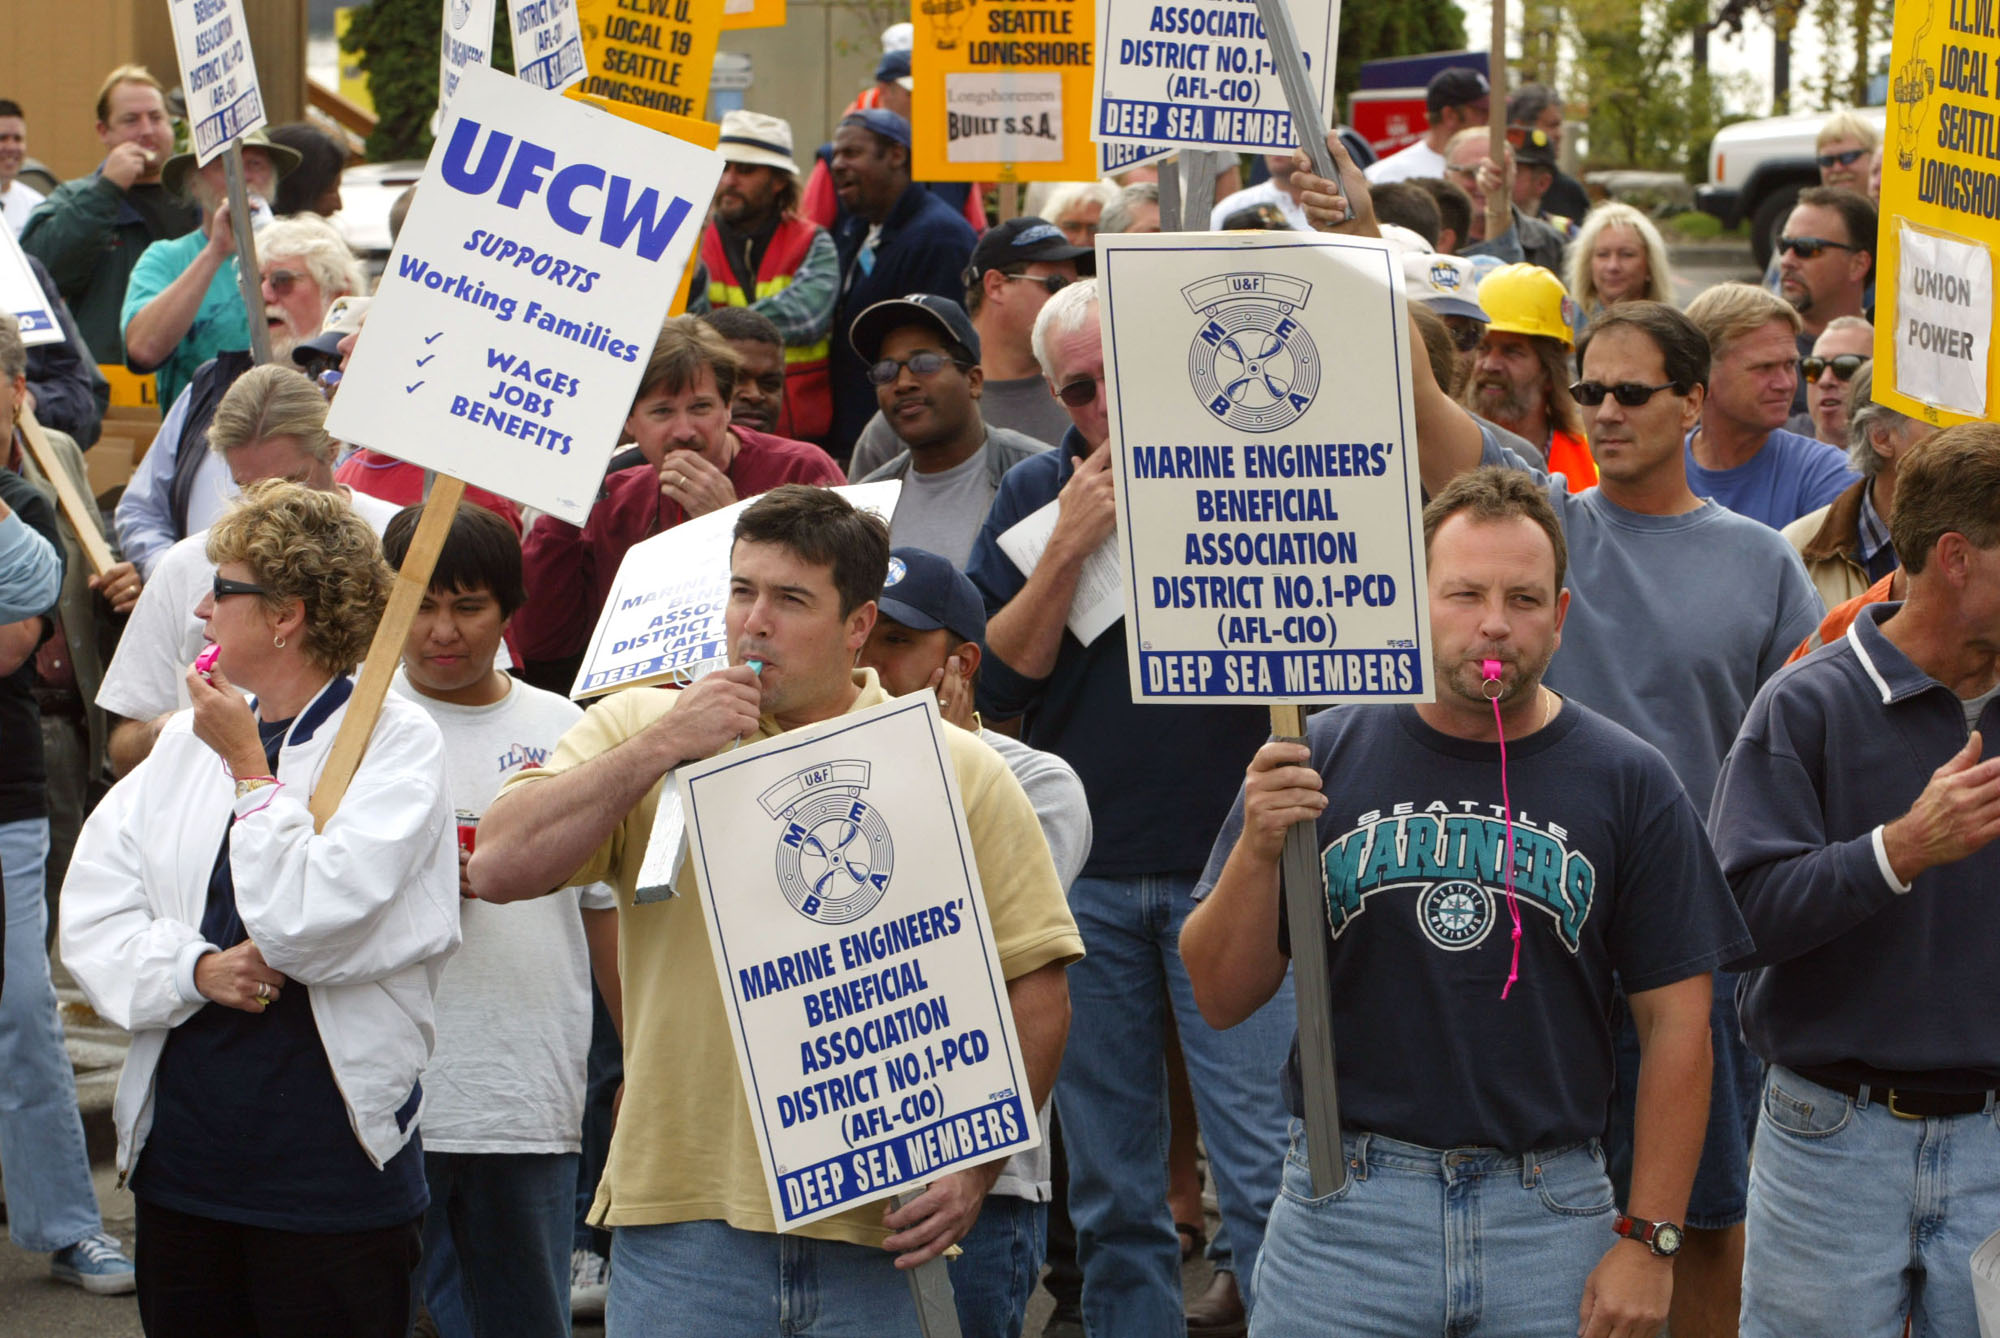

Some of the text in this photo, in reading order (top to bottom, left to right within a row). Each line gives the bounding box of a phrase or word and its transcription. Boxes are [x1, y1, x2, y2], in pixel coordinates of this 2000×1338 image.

[605, 15, 692, 56] LOCAL 19
[988, 10, 1073, 34] SEATTLE
[1149, 6, 1267, 40] ASSOCIATIO
[1949, 0, 2000, 39] I.L.W.
[603, 47, 683, 87] SEATTLE
[968, 41, 1092, 66] LONGSHORE
[1120, 39, 1209, 71] DISTRICT
[1939, 43, 1989, 97] LOCAL
[948, 88, 1055, 106] Longshoremen
[1167, 73, 1261, 108] (AFL-CIO)
[948, 111, 1056, 142] BUILT S.S.A.
[1105, 102, 1300, 147] DEEP SEA MEMBER
[441, 117, 693, 262] UFCW
[1918, 157, 2000, 220] LONGSHO
[463, 229, 600, 293] SUPPORTS
[1232, 278, 1260, 291] U&F
[1914, 267, 1971, 307] UNION
[398, 254, 640, 363] Working Families
[1908, 318, 1974, 361] POWER
[486, 347, 581, 397] WAGES
[488, 380, 554, 418] JOBS
[450, 394, 574, 455] BENEFITS
[1132, 443, 1393, 479] MARINE ENGINEERS'
[1195, 488, 1338, 522] BENEFICIAL
[1185, 531, 1357, 565] ASSOCIATION
[1152, 575, 1263, 609] DISTRICT
[1273, 574, 1396, 609] NO.1-PCD
[648, 599, 724, 629] ASSOC
[1217, 612, 1337, 649] (AFL-CIO)
[611, 616, 713, 655] DISTRICT
[588, 661, 651, 689] DEEP
[659, 646, 703, 671] SEA
[1148, 653, 1413, 693] DEEP SEA MEMBERS
[804, 768, 829, 787] U&F
[1357, 800, 1568, 841] SEATTLE
[1322, 814, 1595, 950] MARINERS
[1433, 885, 1483, 905] SEATTLE
[1431, 916, 1482, 939] MARINERS
[739, 898, 964, 1003] MARINE ENGINEERS'
[803, 959, 928, 1028] BENEFICIAL
[800, 995, 950, 1075] ASSOCIATION
[776, 1029, 990, 1129] DISTRICT NO.1-PCD
[841, 1083, 945, 1149] (AFL-CIO)
[785, 1103, 1019, 1216] DEEP SEA MEMBERS
